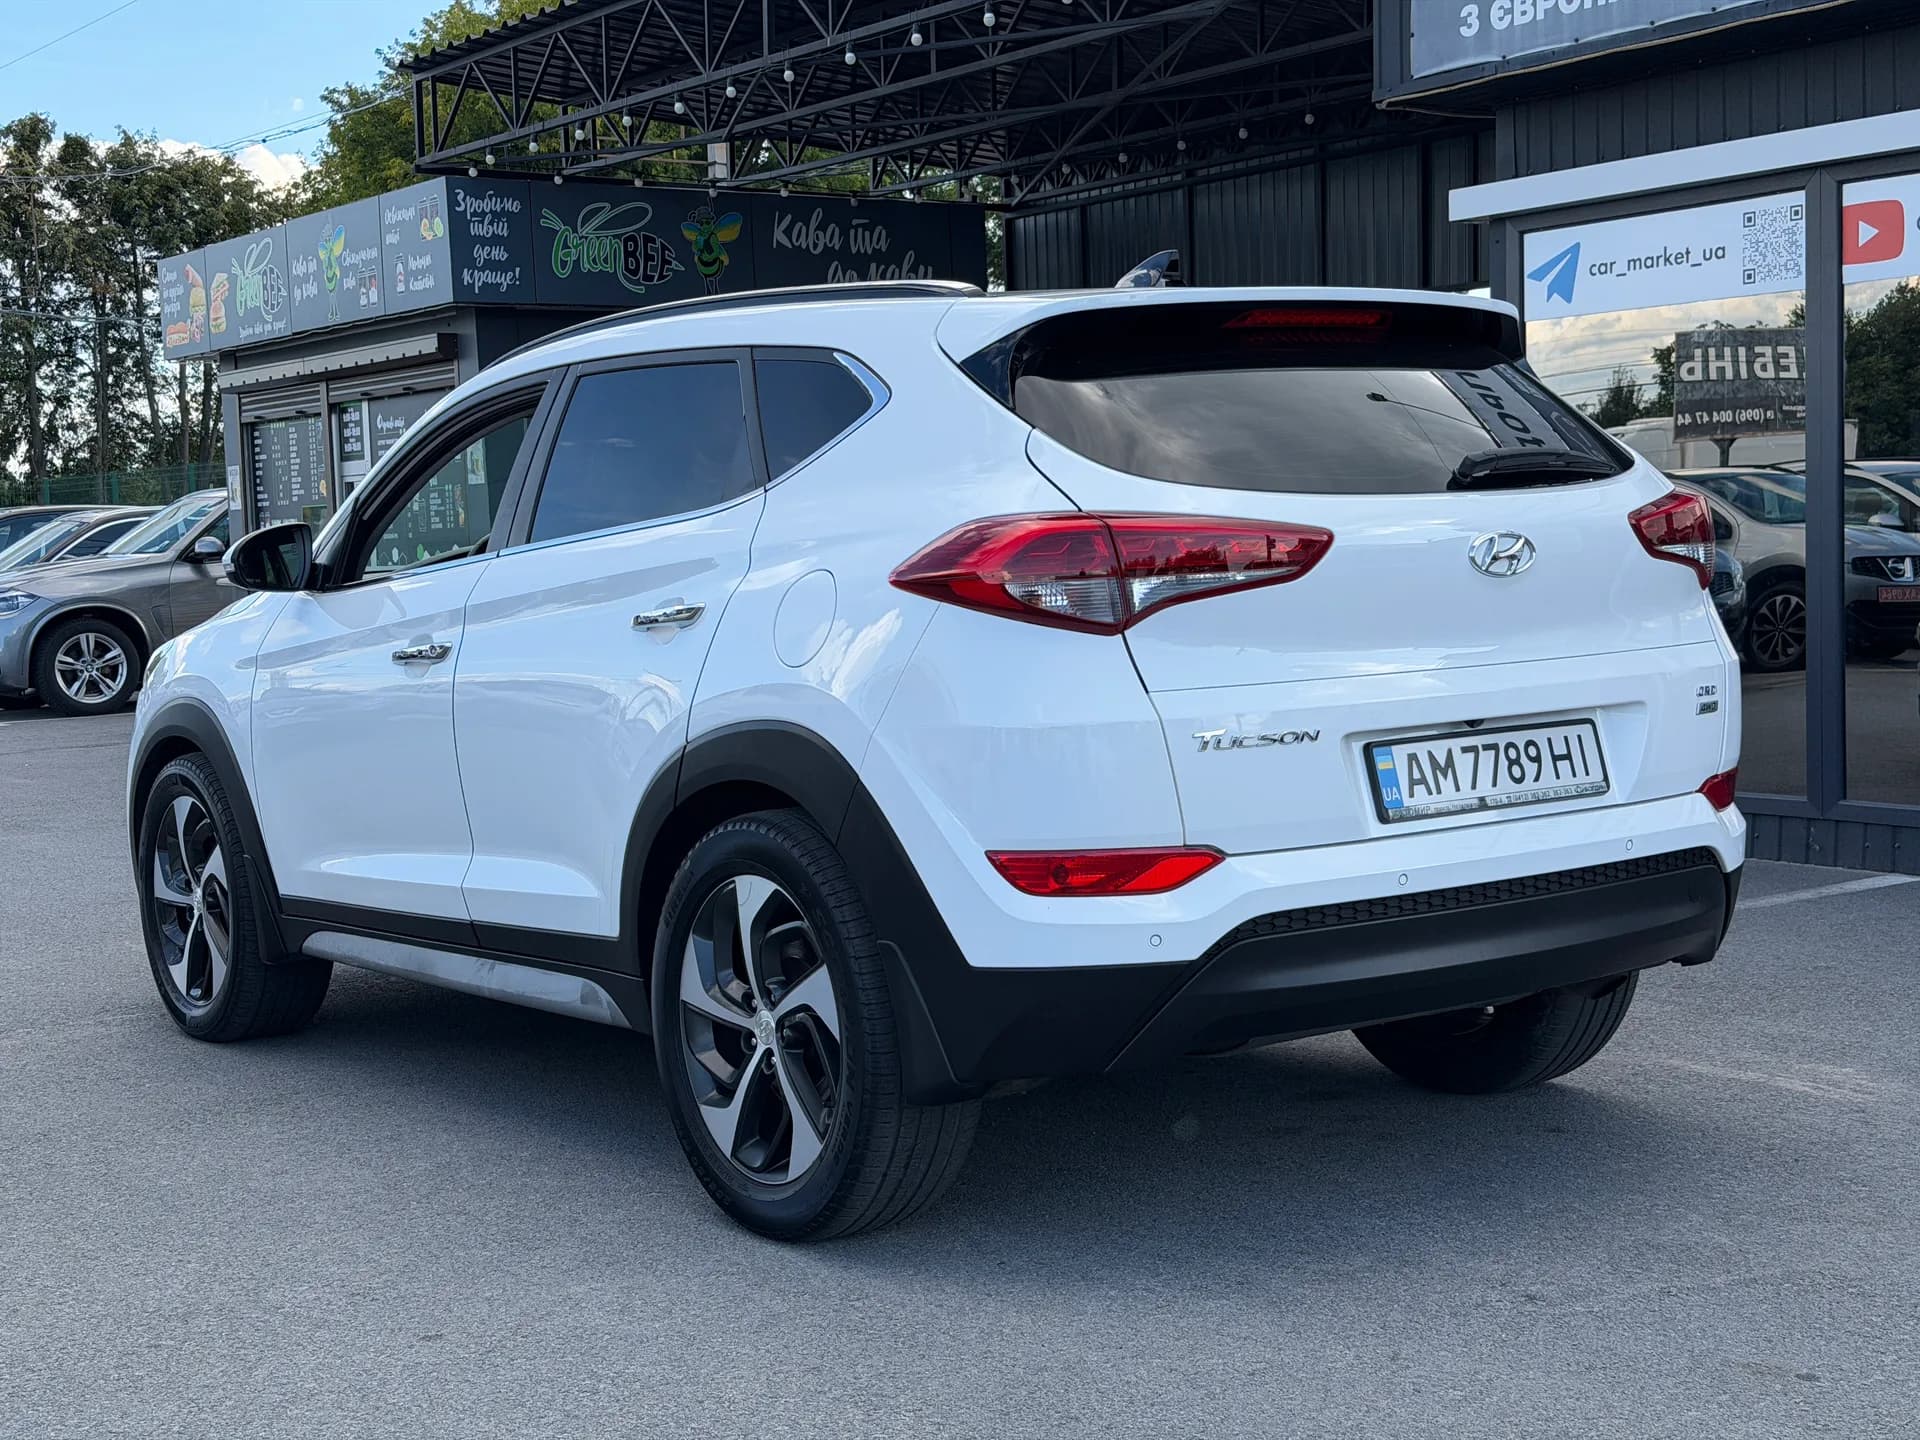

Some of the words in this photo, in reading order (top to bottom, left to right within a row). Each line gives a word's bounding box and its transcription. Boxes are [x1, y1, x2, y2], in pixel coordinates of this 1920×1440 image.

[455, 189, 521, 219] Зробимо
[470, 213, 509, 237] твій
[773, 208, 844, 255] Кава
[850, 219, 891, 254] та
[473, 244, 509, 267] день
[1589, 245, 1726, 277] car_market_ua
[461, 267, 520, 294] краще!
[1192, 728, 1321, 752] TUCSON
[1383, 786, 1401, 801] UA
